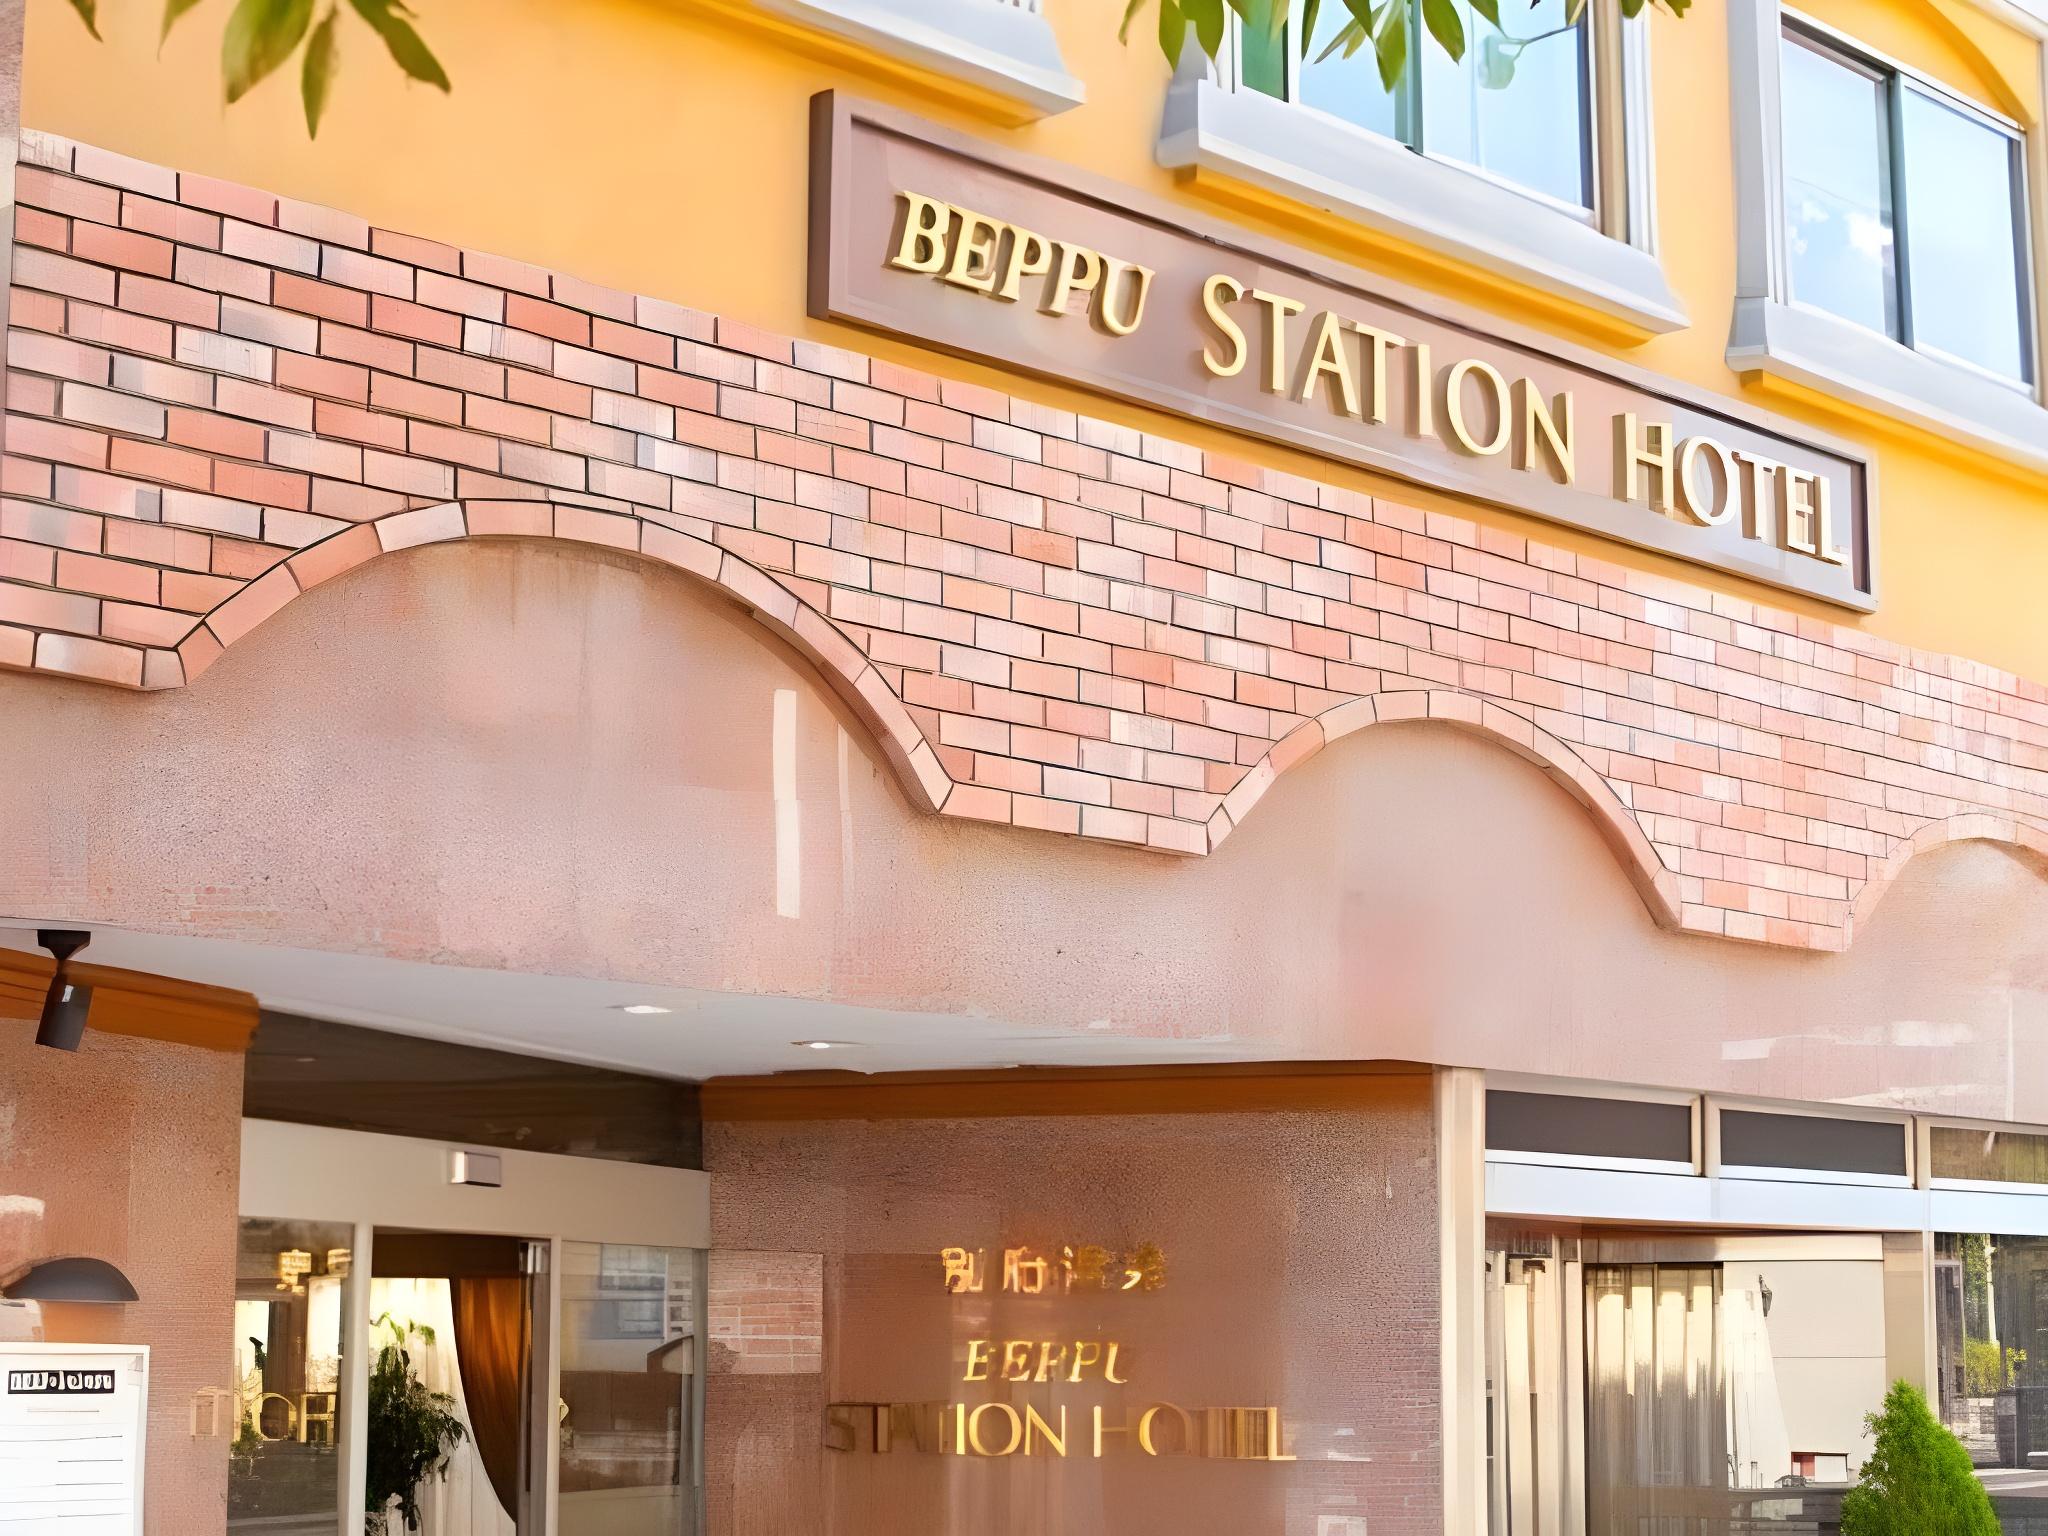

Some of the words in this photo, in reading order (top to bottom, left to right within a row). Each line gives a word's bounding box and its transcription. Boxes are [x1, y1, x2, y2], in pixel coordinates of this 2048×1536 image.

[888, 190, 1155, 336] BEPPU
[1202, 273, 1575, 488] STATION
[1614, 412, 1849, 566] HOTEL
